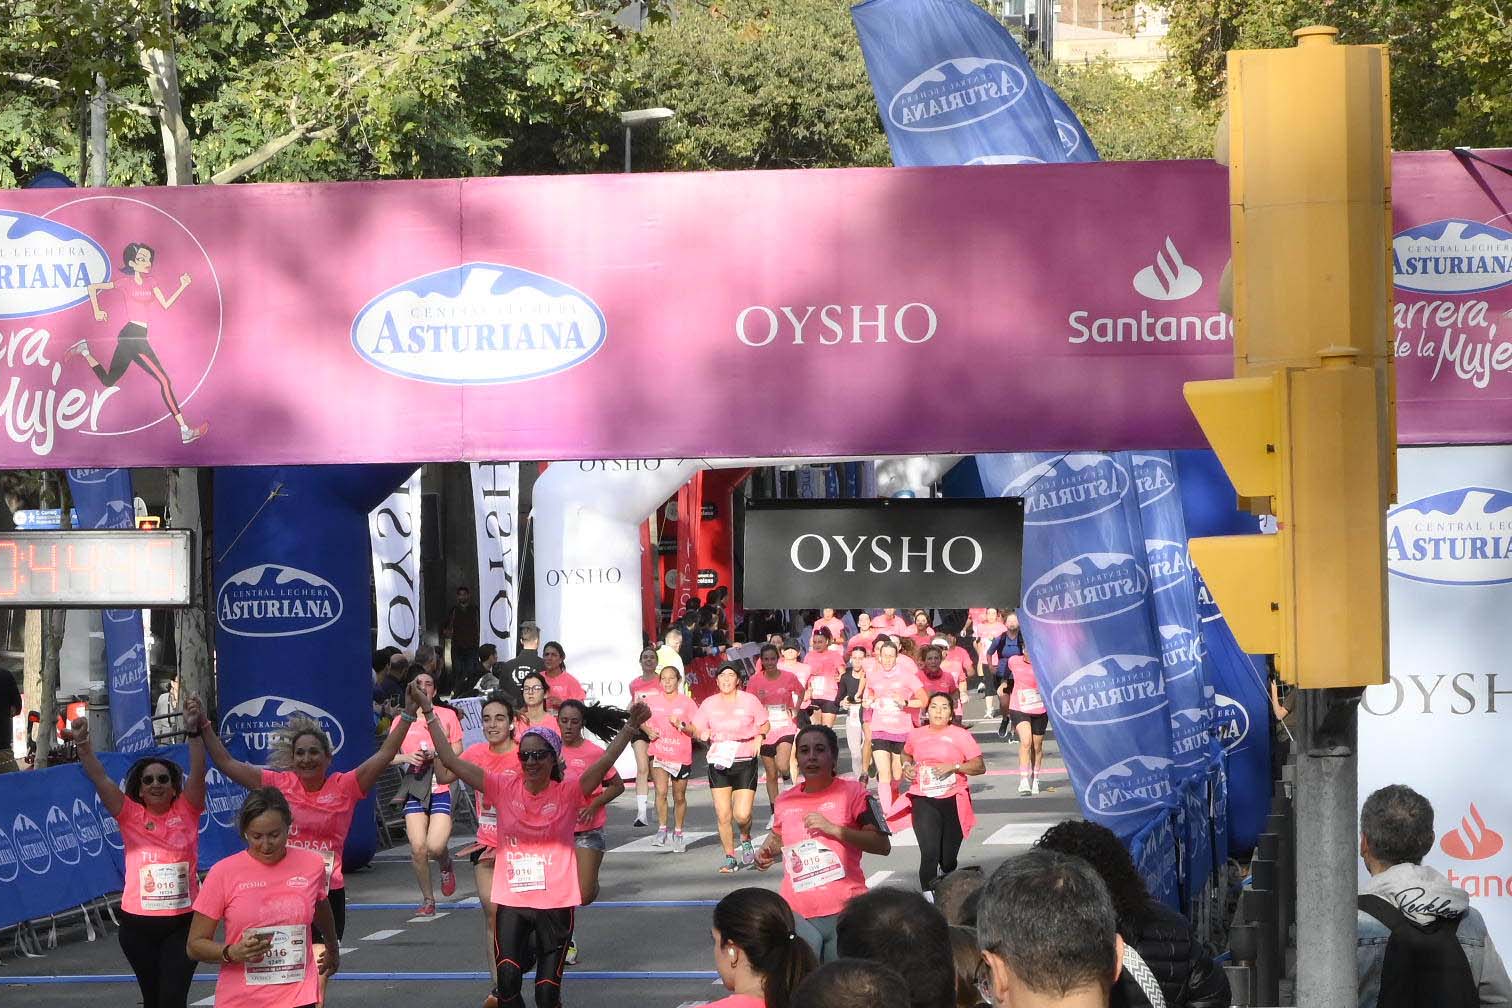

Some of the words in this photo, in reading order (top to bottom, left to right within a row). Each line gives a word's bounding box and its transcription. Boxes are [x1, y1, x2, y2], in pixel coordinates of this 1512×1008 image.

[14, 247, 87, 257] LECHERA
[1408, 245, 1458, 253] CENTRAL
[1465, 244, 1512, 252] LECHER
[735, 302, 938, 347] OYSHO
[1068, 310, 1234, 343] Santand
[1394, 300, 1488, 328] arrera
[371, 310, 586, 354] ASTURIANA
[1418, 331, 1434, 357] la
[1431, 324, 1512, 388] Muje
[790, 533, 983, 575] OYSHO
[546, 567, 622, 587] OYSHO
[221, 594, 333, 620] ASTURIANA
[1361, 672, 1512, 716] OYSH
[141, 852, 157, 863] TU
[266, 949, 287, 958] 016
